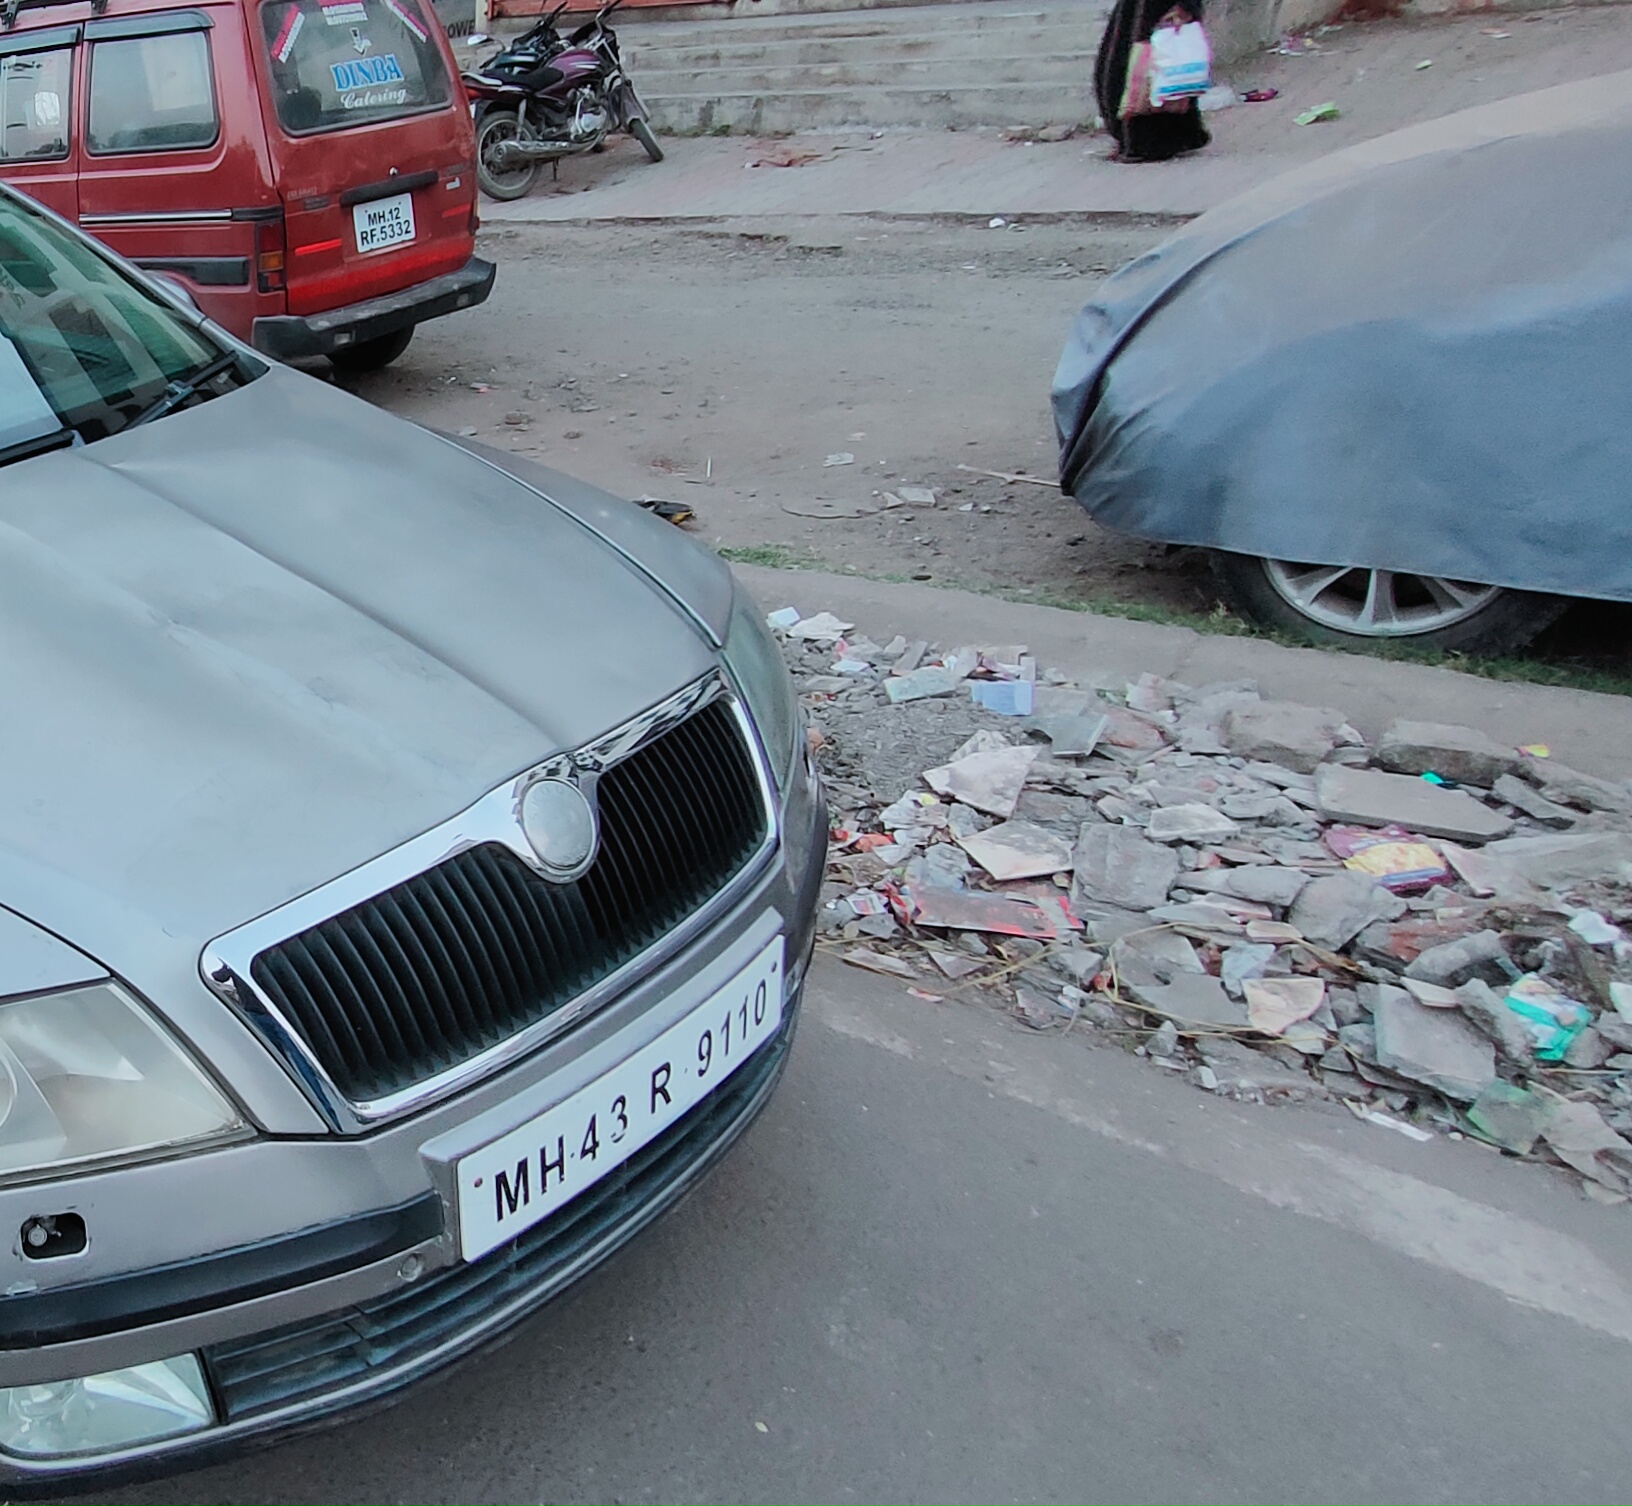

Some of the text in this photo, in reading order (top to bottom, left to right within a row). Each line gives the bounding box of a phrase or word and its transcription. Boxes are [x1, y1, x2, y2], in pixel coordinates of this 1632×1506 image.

[329, 53, 405, 92] DINBA
[340, 88, 407, 109] Catering
[360, 219, 412, 246] RF.5332
[650, 1062, 672, 1114] R
[696, 978, 767, 1078] 9110
